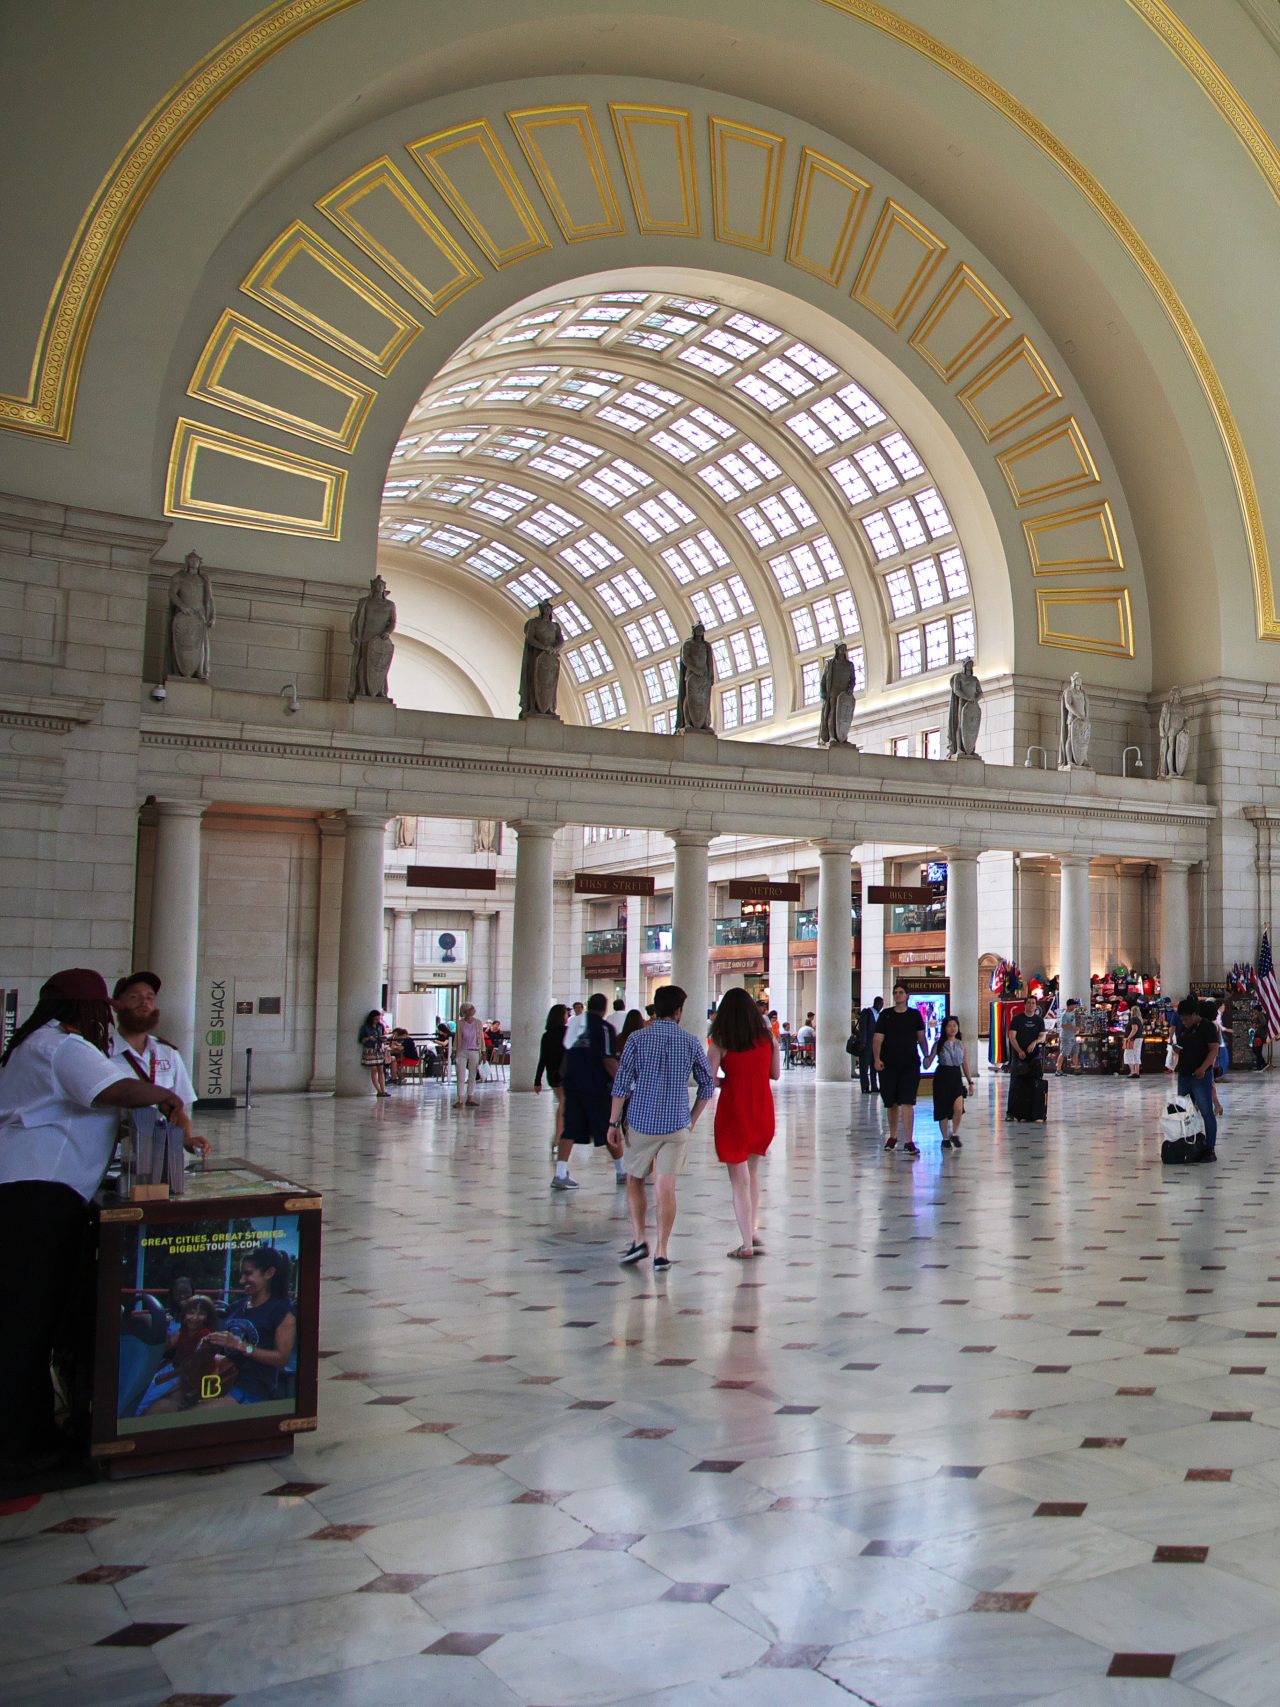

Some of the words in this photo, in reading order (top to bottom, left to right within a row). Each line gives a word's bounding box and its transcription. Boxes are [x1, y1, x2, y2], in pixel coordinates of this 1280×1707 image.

[579, 878, 610, 889] FIRST
[612, 880, 651, 891] STREET
[750, 886, 783, 896] METRO
[889, 890, 913, 900] BIKES
[210, 980, 226, 1028] SHACK
[208, 1048, 224, 1095] SHAKE
[140, 1237, 174, 1247] GREAT
[176, 1234, 210, 1245] CITIES.
[212, 1232, 242, 1242] GREAT
[244, 1230, 287, 1240] STORIES.
[168, 1240, 260, 1254] BIGBUSTOURS.COM
